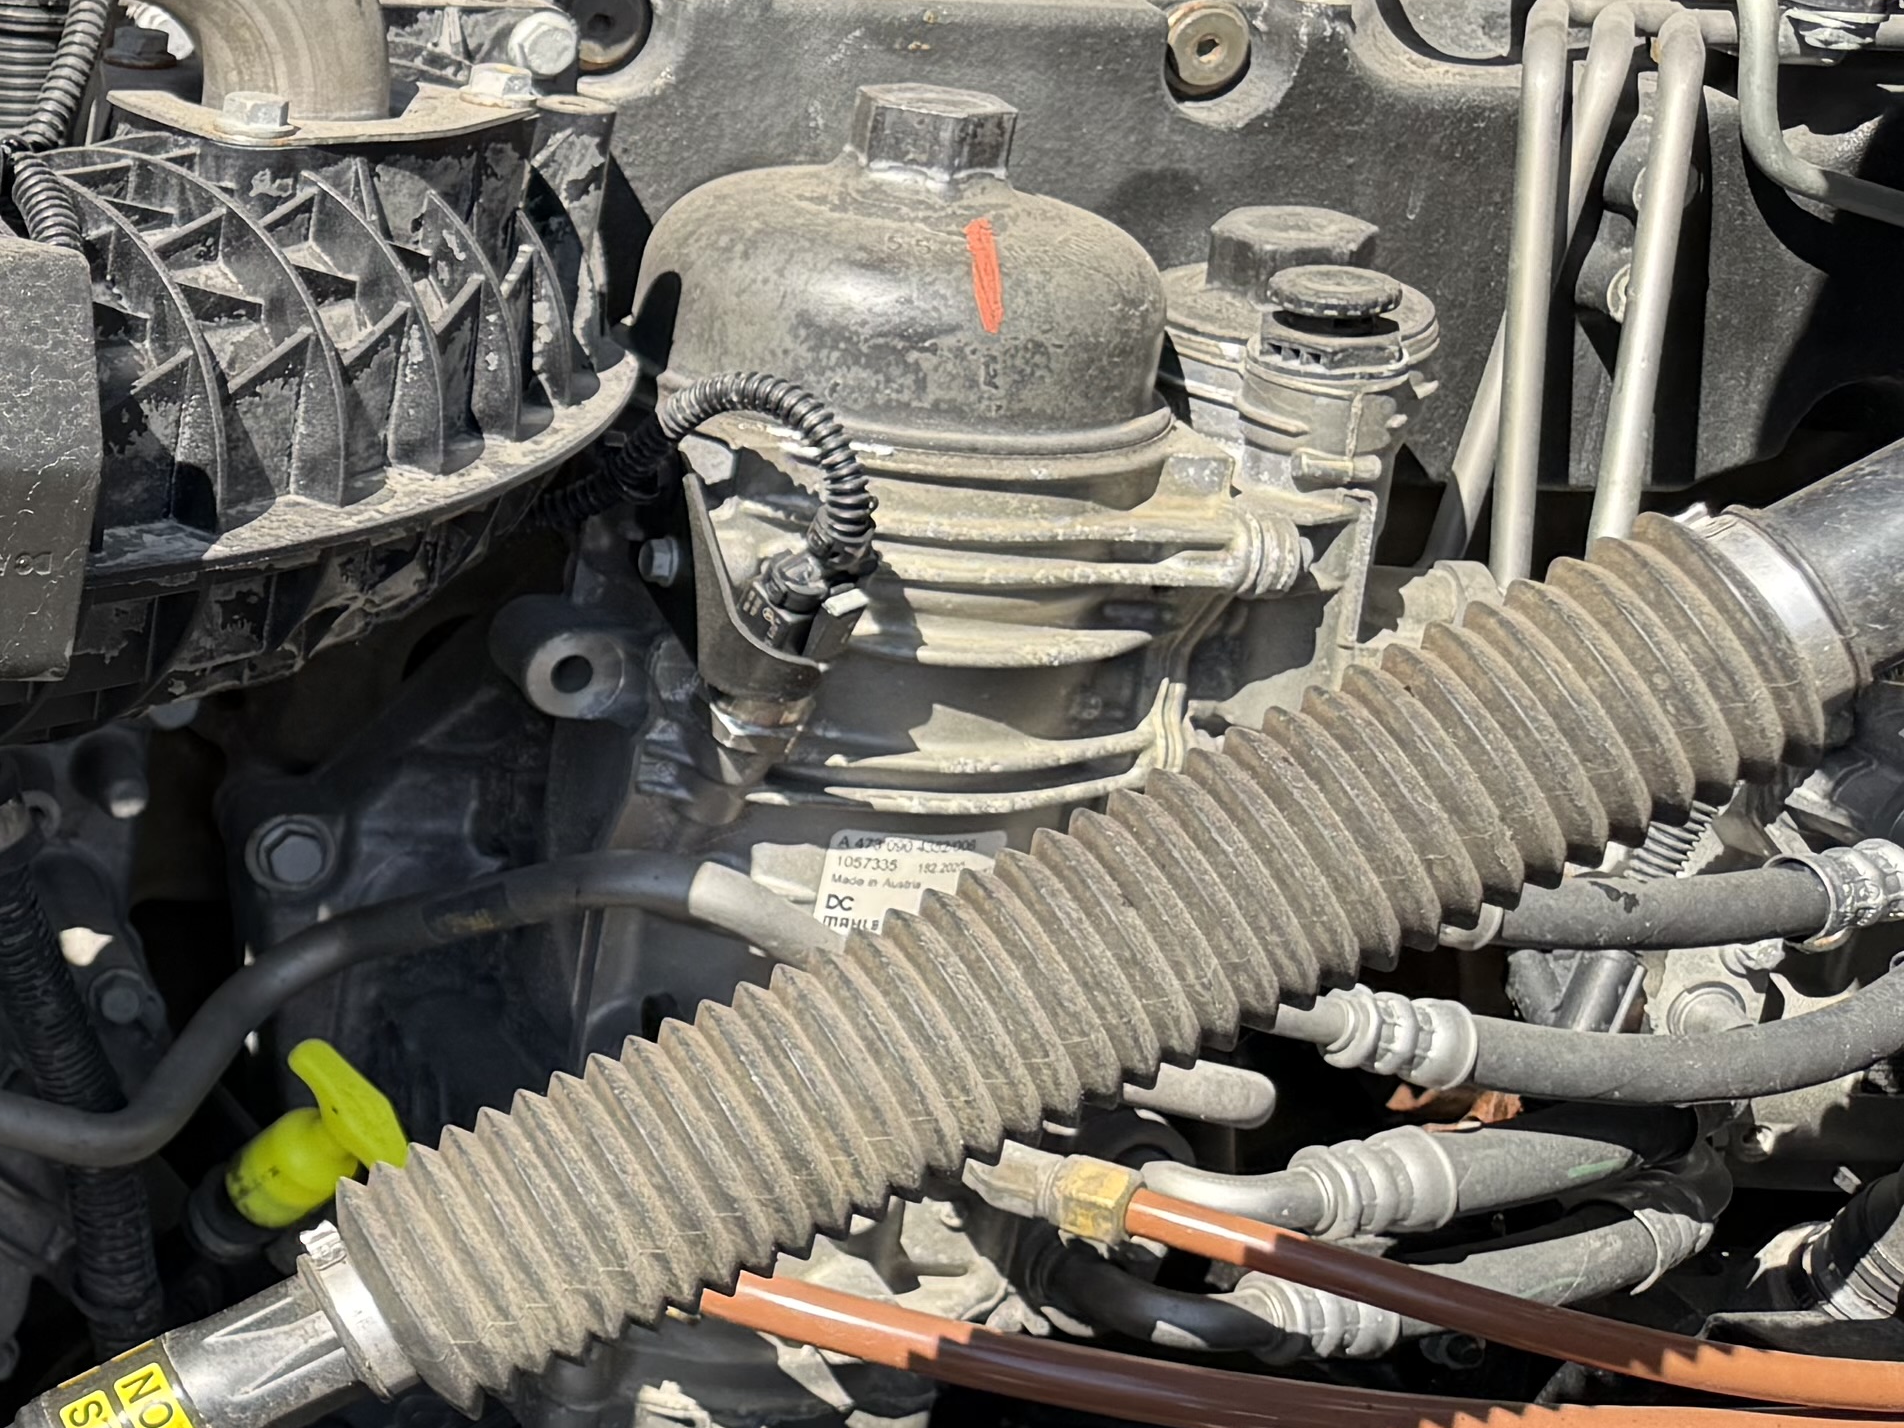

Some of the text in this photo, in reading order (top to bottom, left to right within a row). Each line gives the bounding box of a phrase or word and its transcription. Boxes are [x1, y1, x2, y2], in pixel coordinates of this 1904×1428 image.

[838, 836, 849, 849] A
[838, 856, 898, 871] 1057335
[831, 874, 921, 890] Made in Austria
[825, 894, 854, 911] DC
[122, 1370, 173, 1428] NO
